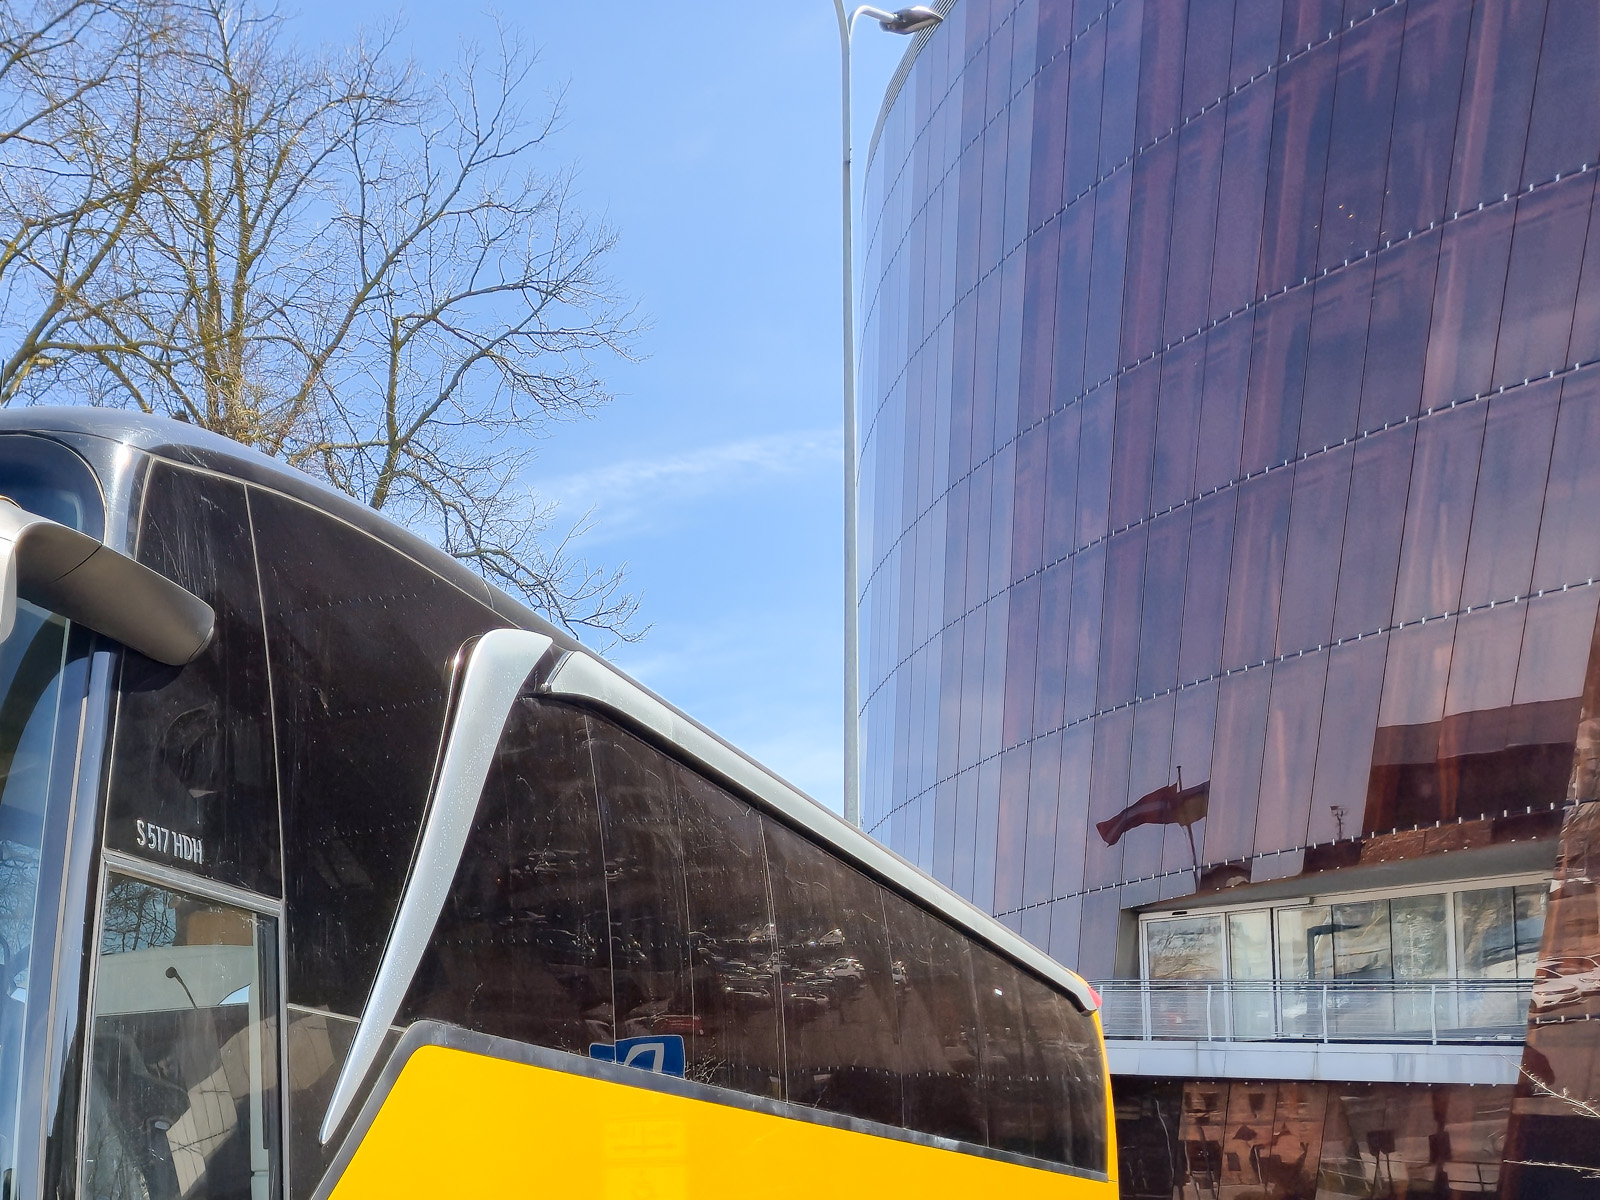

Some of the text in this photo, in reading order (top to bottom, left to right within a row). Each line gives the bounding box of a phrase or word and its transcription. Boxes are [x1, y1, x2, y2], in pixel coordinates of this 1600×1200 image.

[136, 818, 204, 865] S 517 HDH
